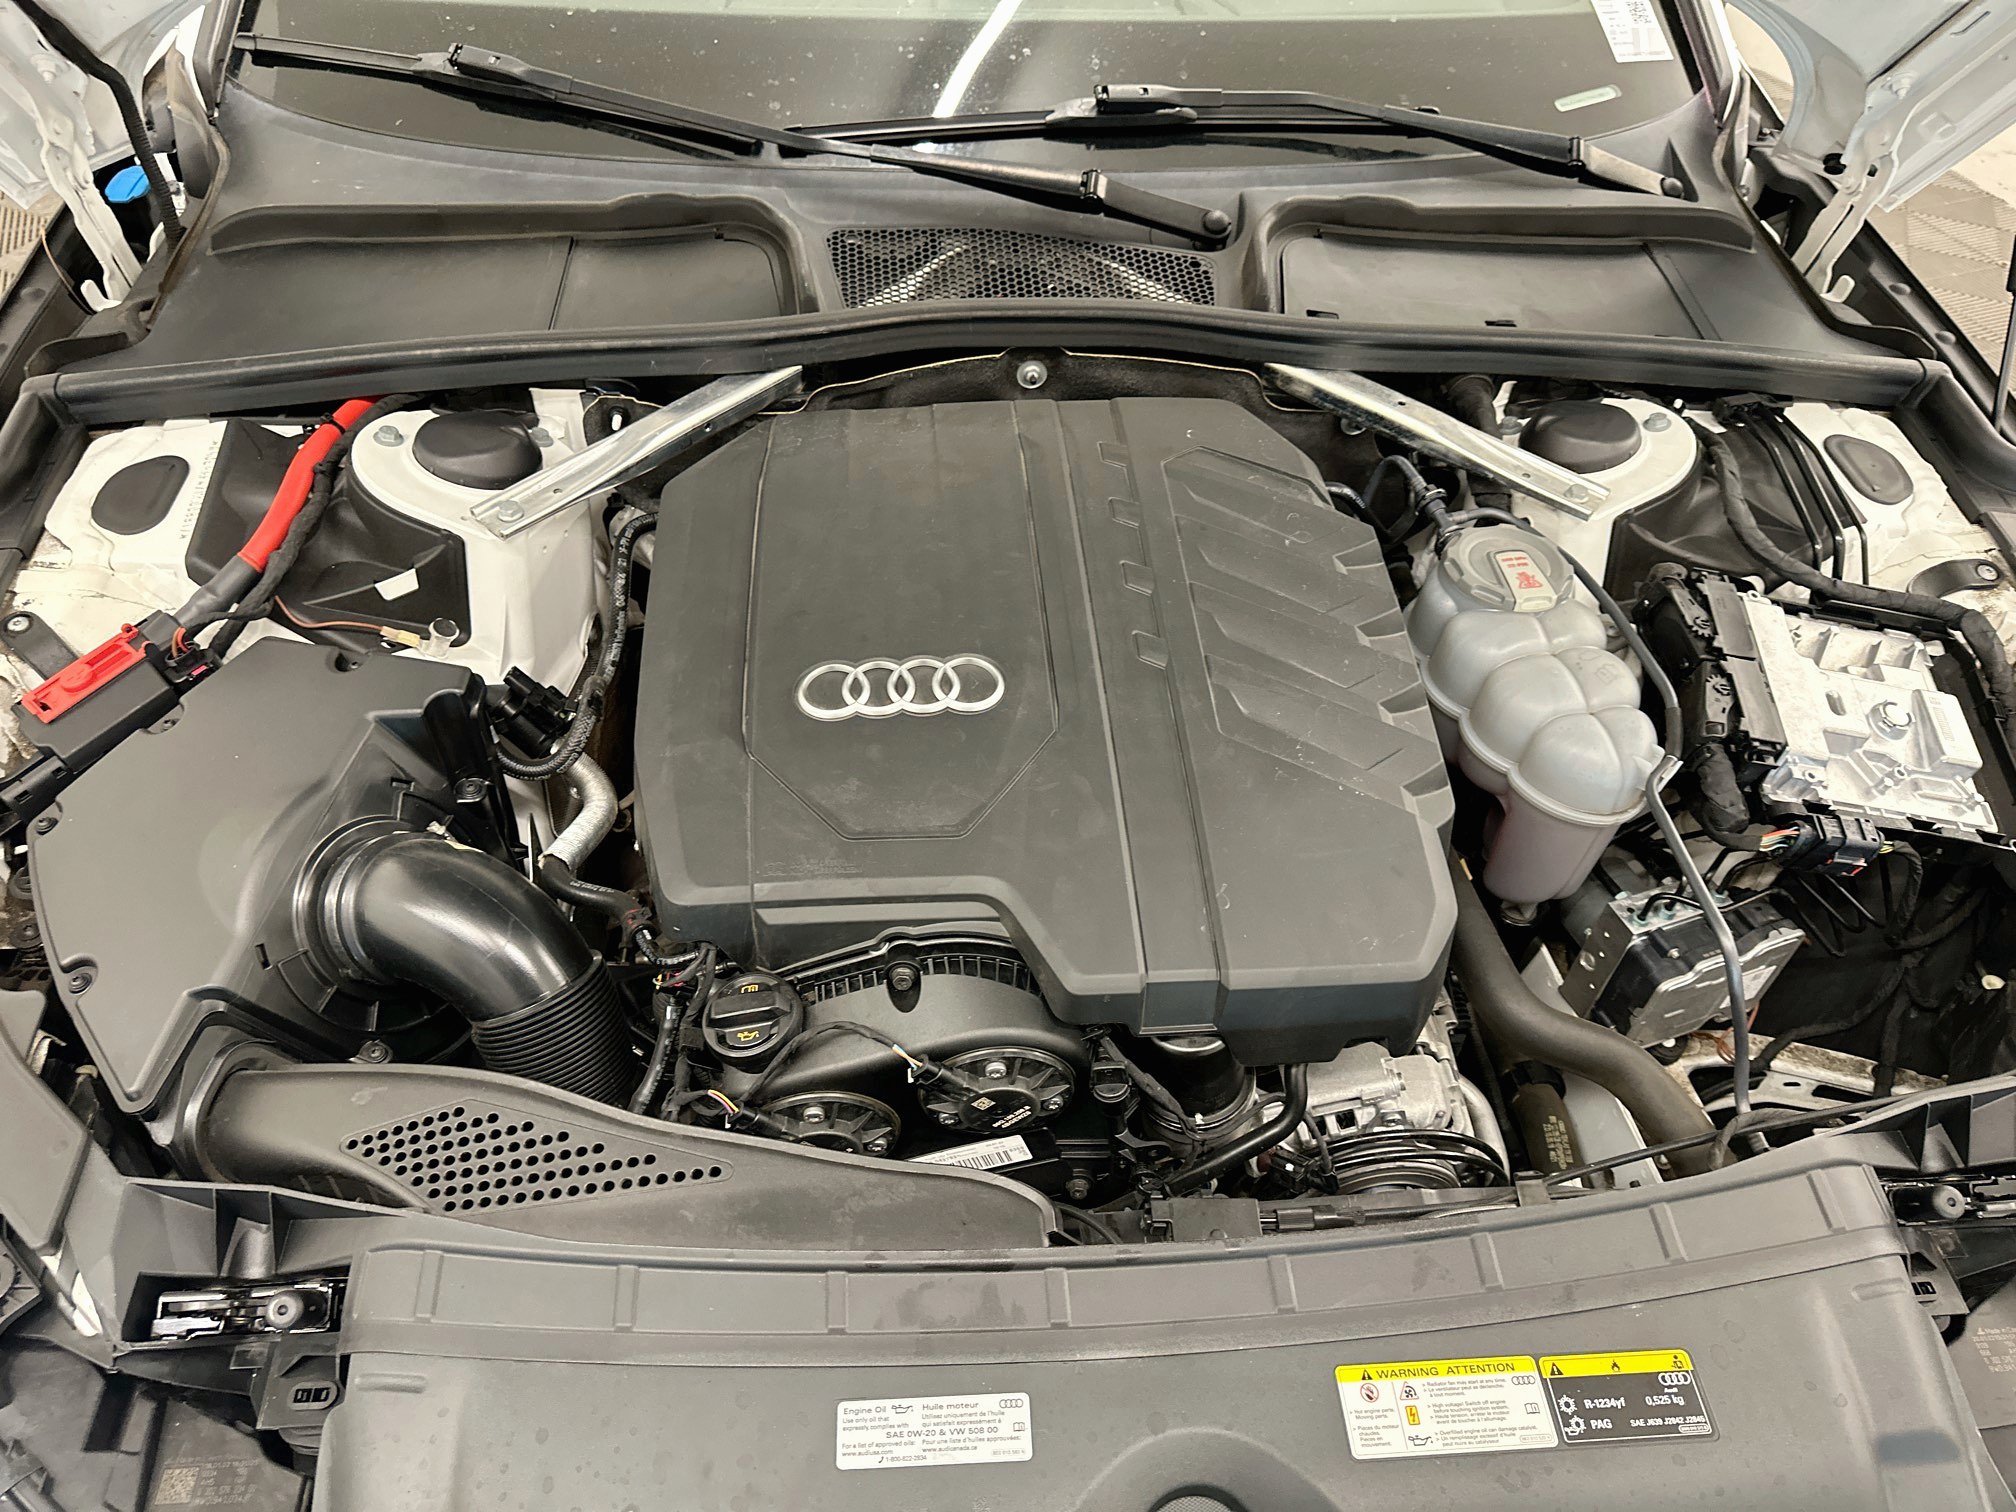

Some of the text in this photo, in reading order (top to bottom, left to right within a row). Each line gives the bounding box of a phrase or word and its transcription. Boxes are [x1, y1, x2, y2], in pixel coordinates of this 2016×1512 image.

[1376, 1363, 1515, 1379] WARNING ATTENTION
[1584, 1394, 1685, 1410] R-1234yf 0,525 kg
[1590, 1419, 1612, 1430] PAG
[1630, 1418, 1646, 1427] SAE
[1647, 1417, 1662, 1426] J639
[1664, 1416, 1684, 1426] J2842
[875, 1441, 902, 1449] approved
